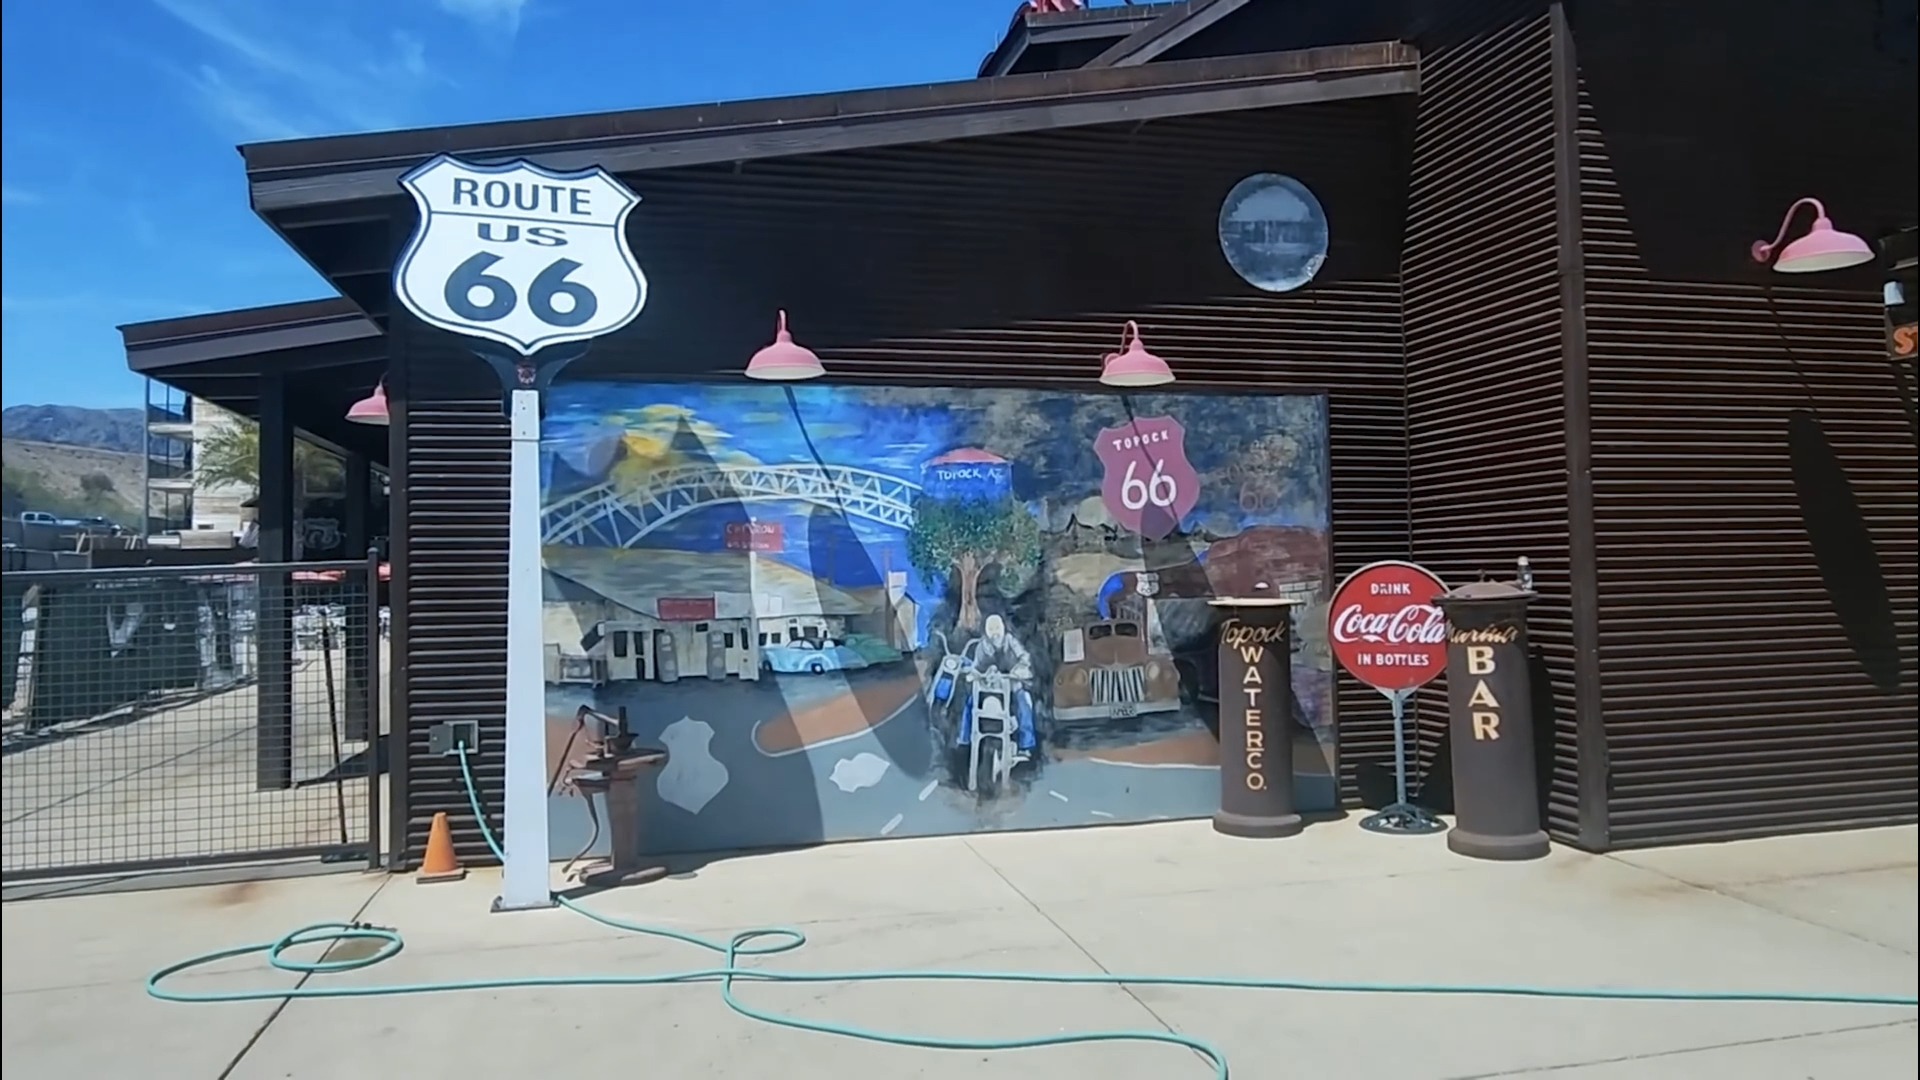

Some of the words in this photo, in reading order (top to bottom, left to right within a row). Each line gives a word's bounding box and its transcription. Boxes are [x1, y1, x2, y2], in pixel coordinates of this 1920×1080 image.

[452, 177, 592, 215] ROUTE
[477, 222, 569, 247] US
[444, 251, 598, 327] 66
[1112, 430, 1169, 451] TOPOCK
[1121, 458, 1177, 510] 66
[1371, 583, 1411, 595] DRINK
[1220, 618, 1285, 649] Topock
[1333, 603, 1446, 644] Coca-Cola
[1357, 653, 1371, 665] IN
[1376, 653, 1429, 666] BOTTLES
[1467, 646, 1501, 740] BAR
